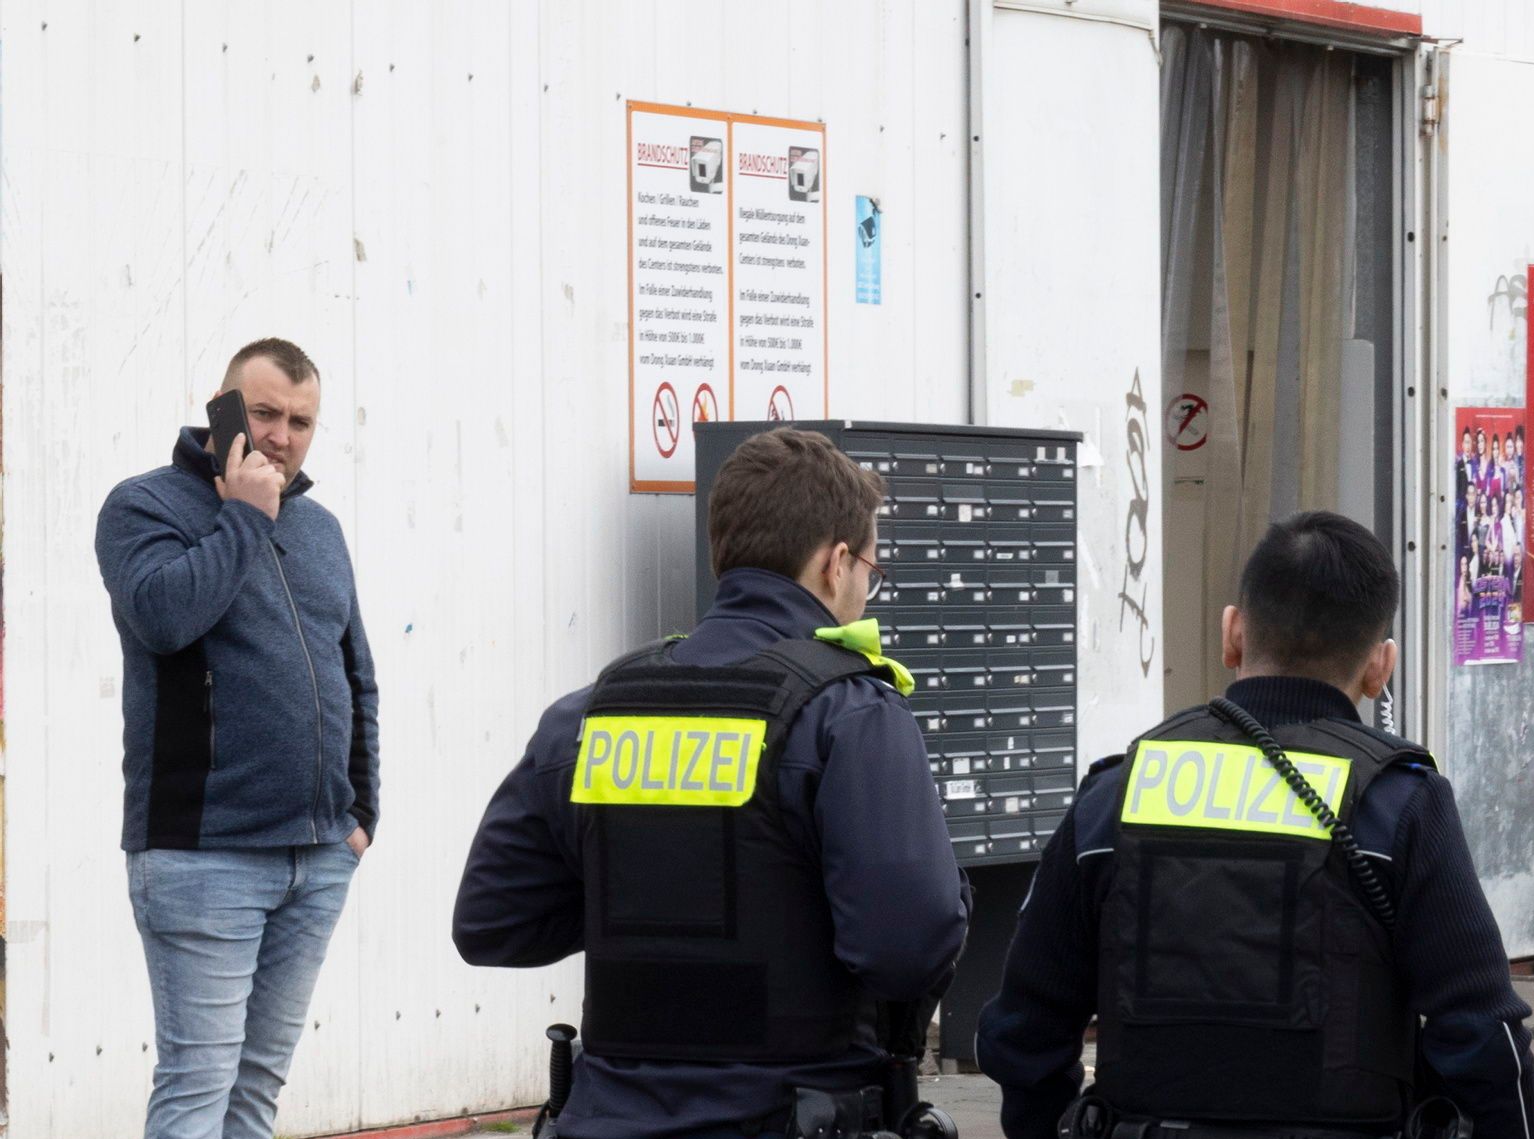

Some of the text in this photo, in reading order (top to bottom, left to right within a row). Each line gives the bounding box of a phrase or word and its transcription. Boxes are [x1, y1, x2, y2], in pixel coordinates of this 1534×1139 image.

[638, 142, 688, 164] BRANDSCHUTZ
[739, 151, 788, 174] BRANDSCHUTZ
[584, 730, 751, 792] POLIZEI
[1130, 749, 1341, 829] POLIZEI
